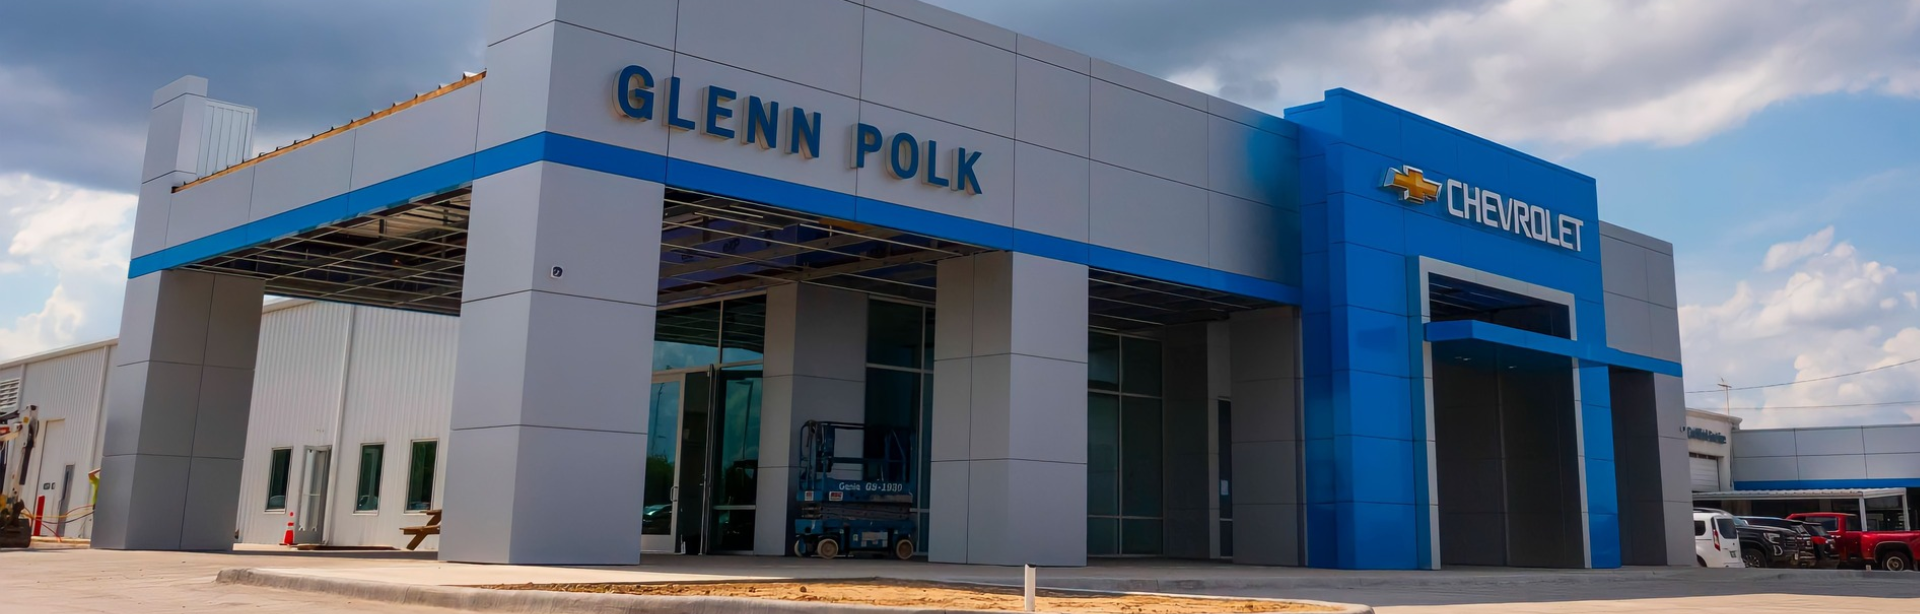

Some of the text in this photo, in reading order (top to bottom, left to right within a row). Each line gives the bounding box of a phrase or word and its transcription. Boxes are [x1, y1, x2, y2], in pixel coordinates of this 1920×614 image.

[613, 65, 983, 195] GLENN POLK
[1447, 178, 1584, 252] CHEVROLET
